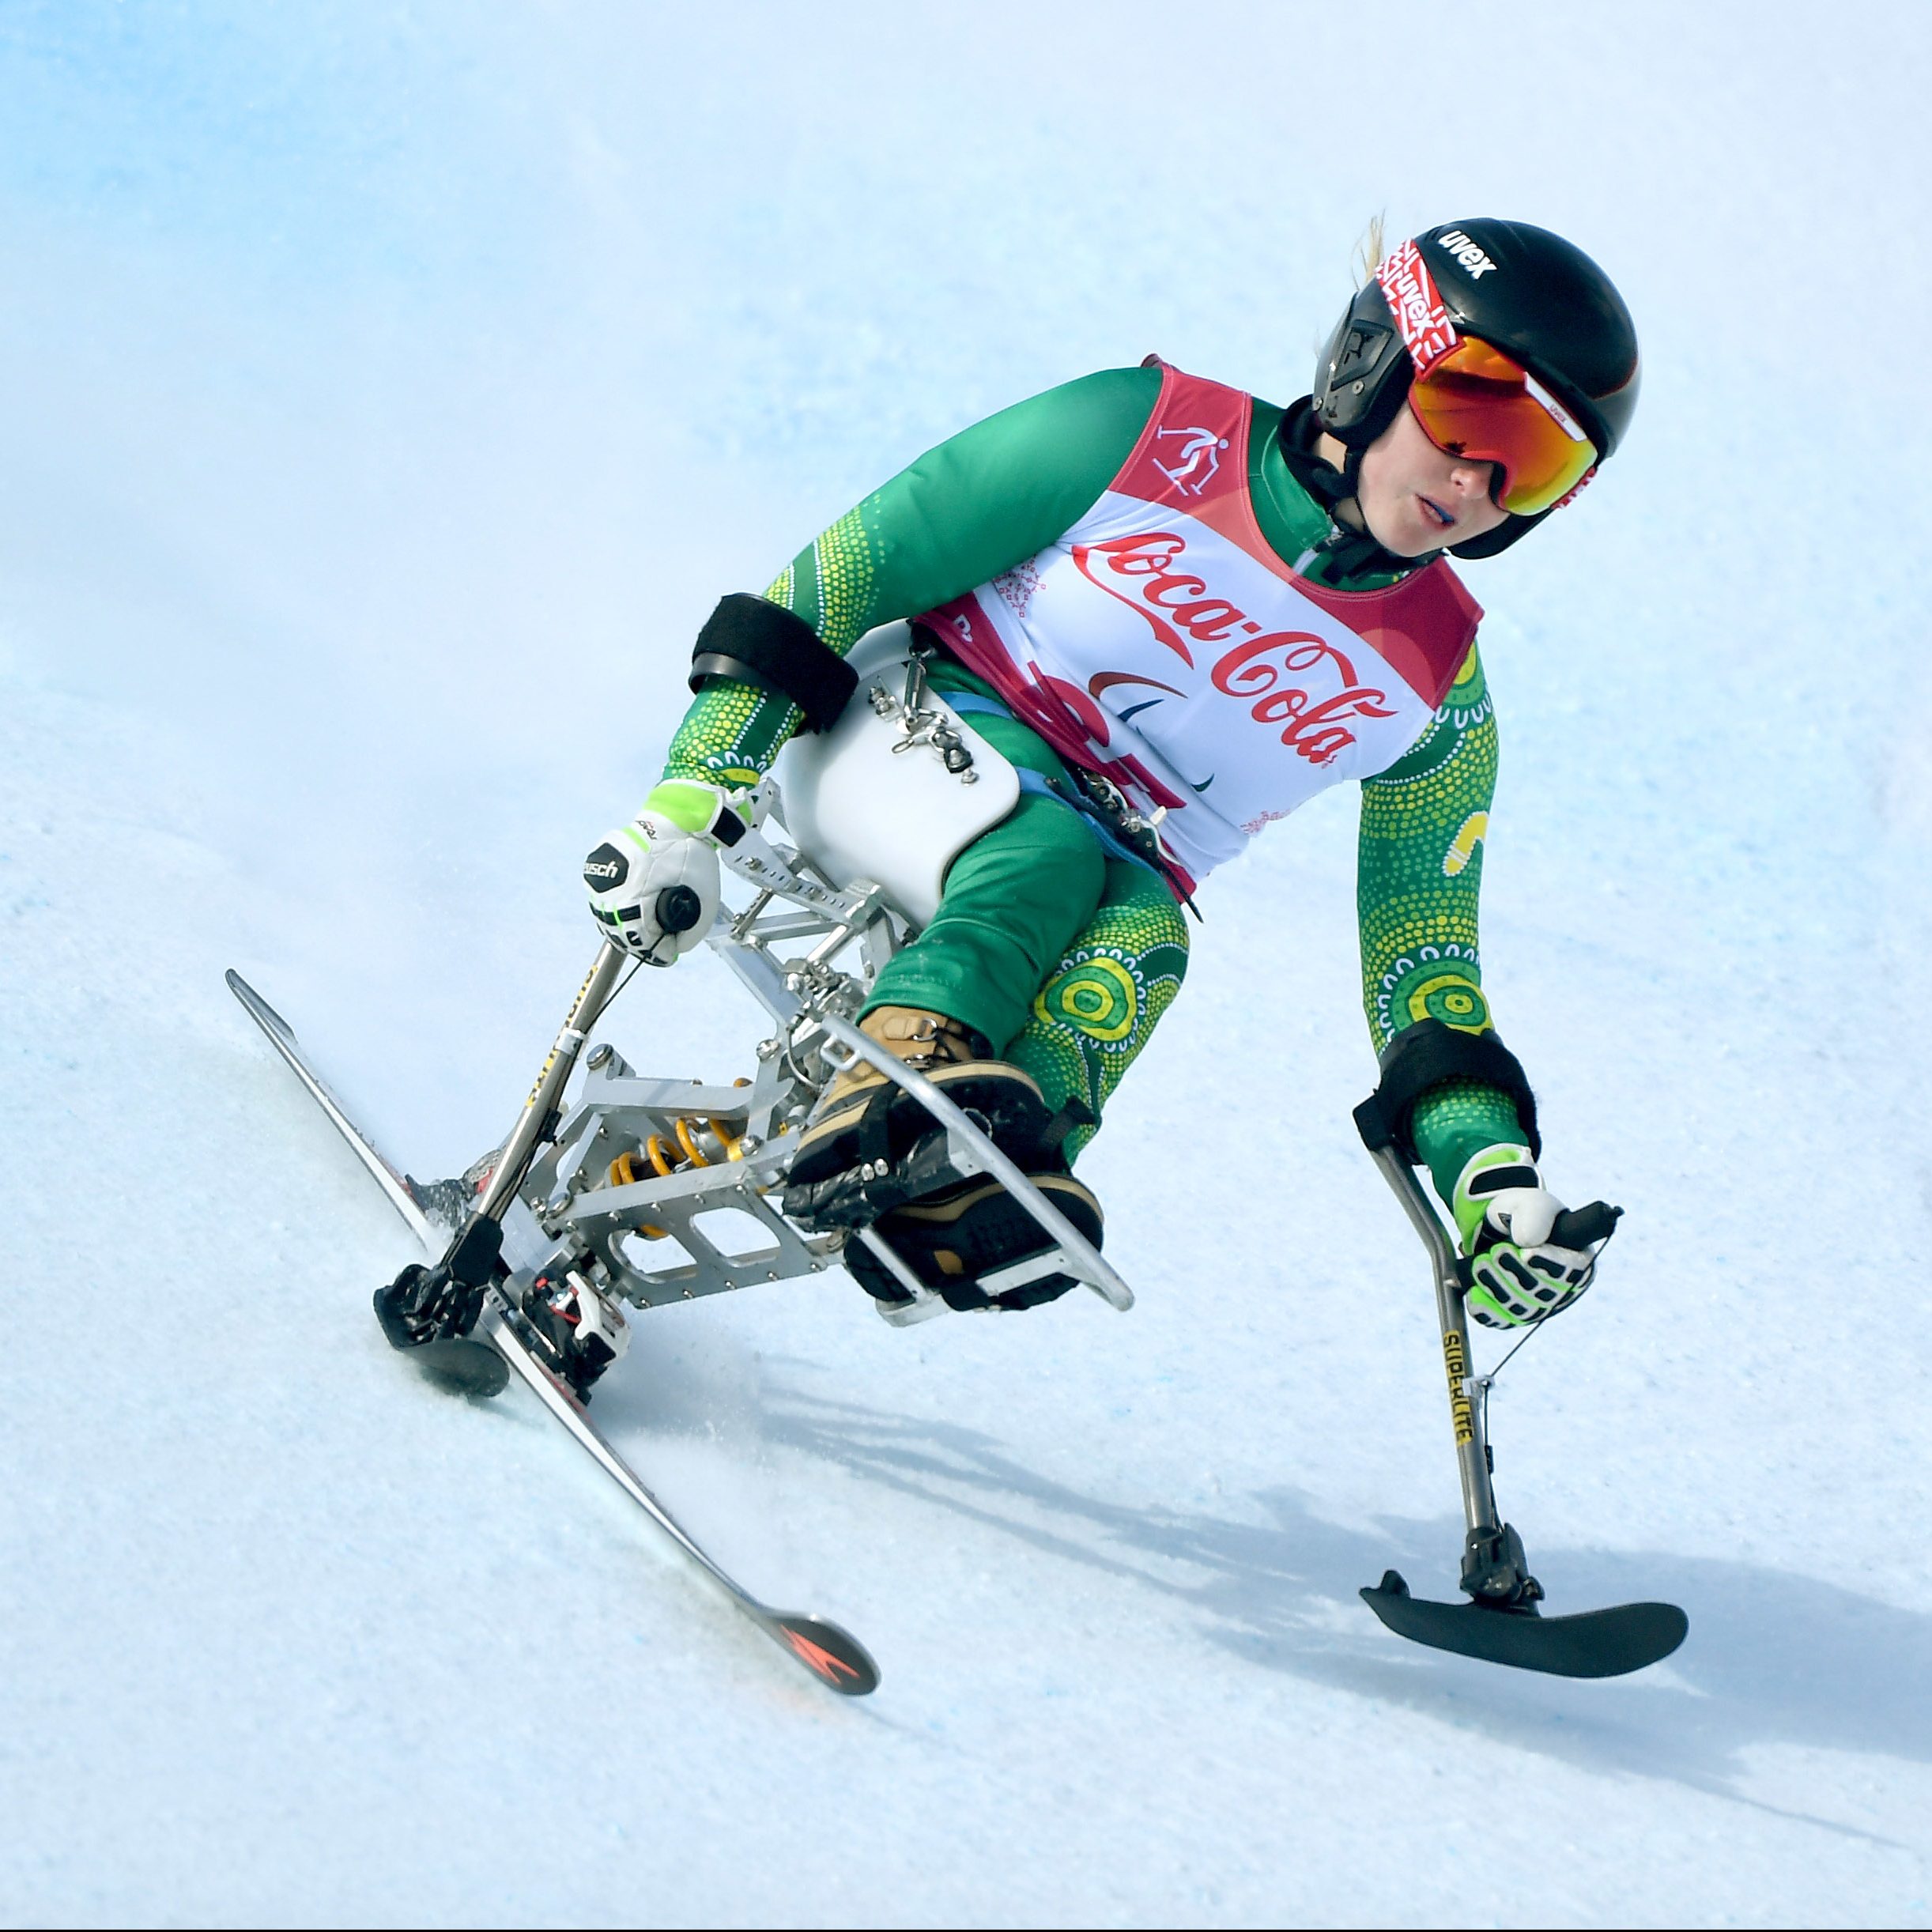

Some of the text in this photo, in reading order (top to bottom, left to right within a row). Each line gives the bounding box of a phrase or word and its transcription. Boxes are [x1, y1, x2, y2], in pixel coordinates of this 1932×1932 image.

[1438, 230, 1498, 280] uvex
[1396, 272, 1436, 339] uvex
[1072, 531, 1400, 764] Coca-Cola
